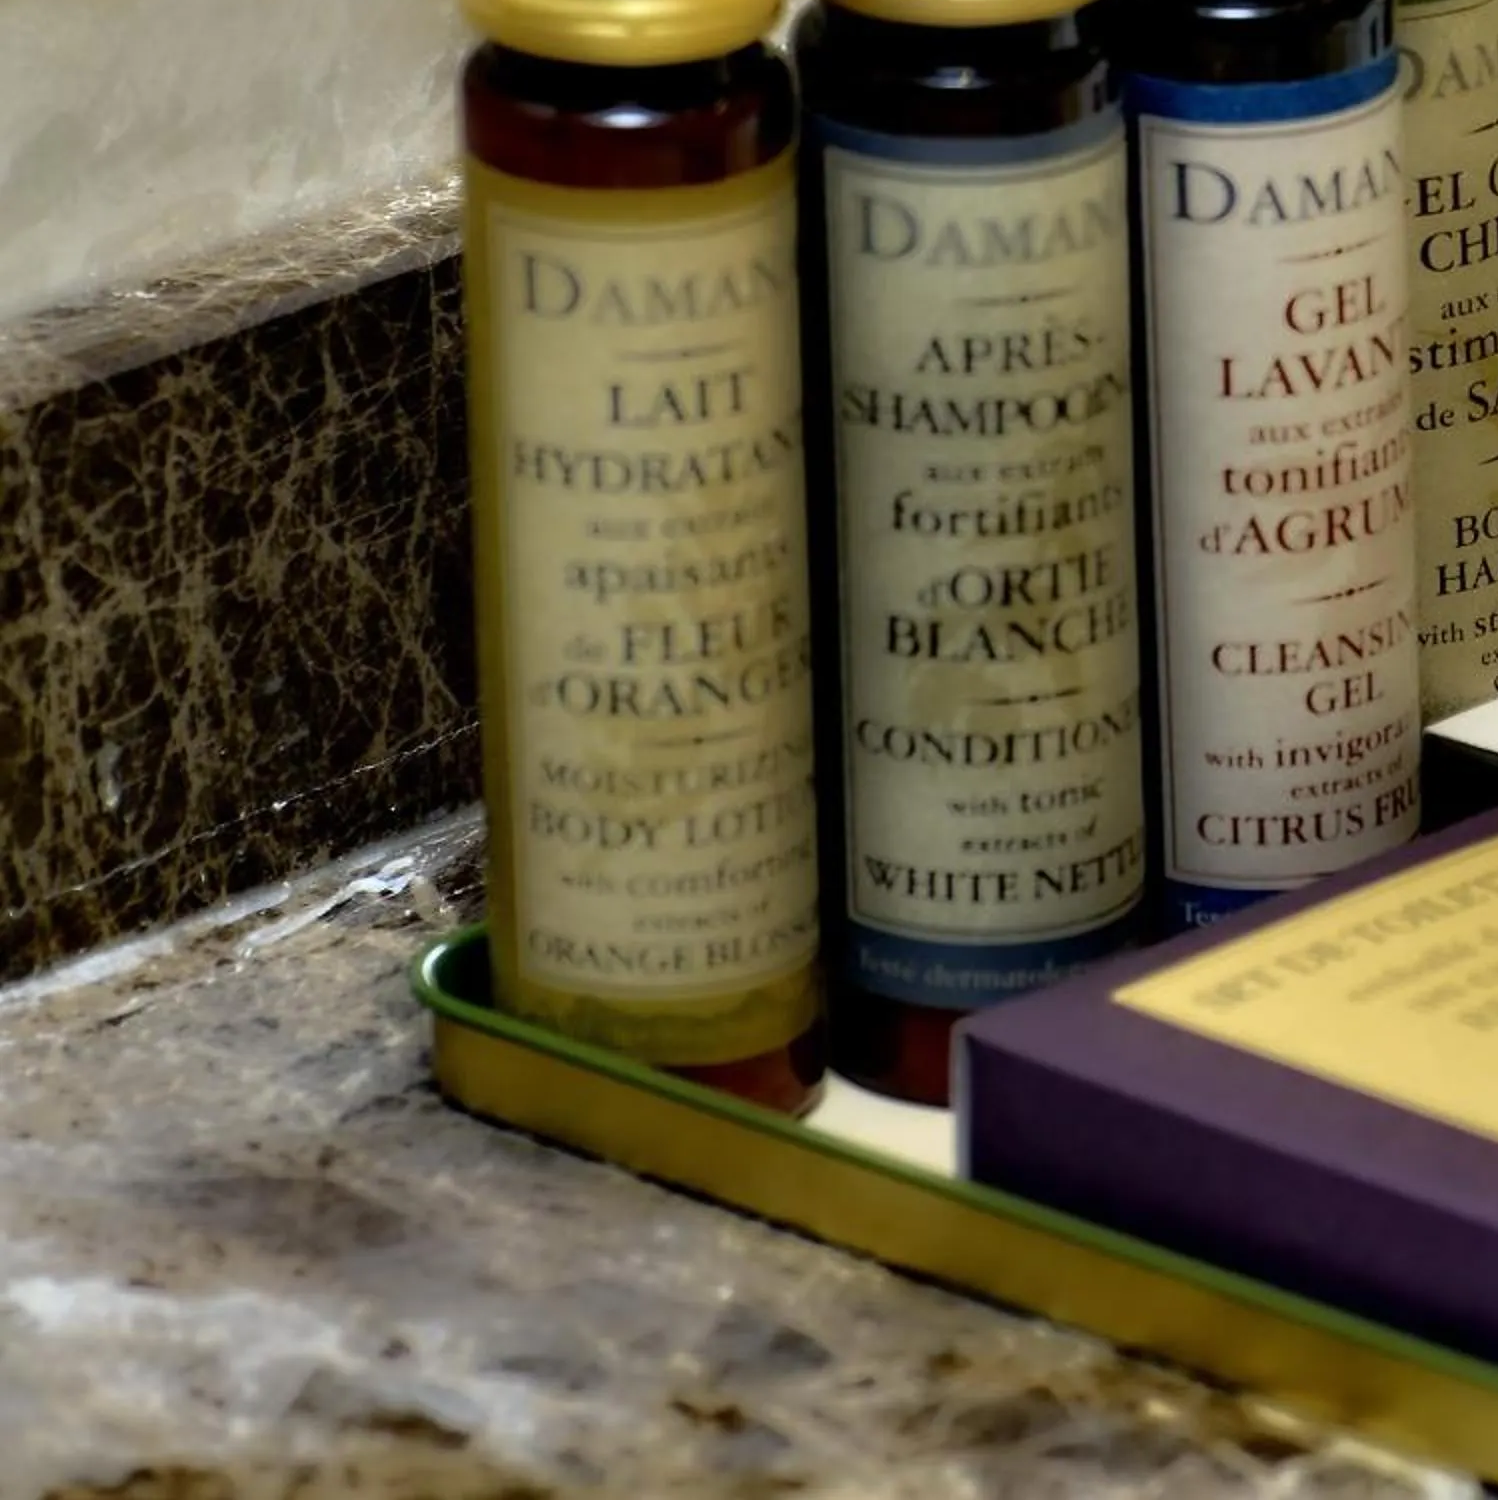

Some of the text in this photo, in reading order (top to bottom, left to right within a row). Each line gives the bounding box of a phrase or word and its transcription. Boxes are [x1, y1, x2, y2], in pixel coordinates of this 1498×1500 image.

[1415, 172, 1476, 218] EL
[1285, 276, 1386, 335] GEL
[1441, 294, 1488, 321] aux
[608, 366, 755, 427] LAIT
[1416, 403, 1455, 431] de
[1307, 671, 1385, 717] GEL
[1204, 746, 1264, 770] with
[1291, 771, 1382, 800] extracts
[529, 801, 661, 849] BODY
[1197, 806, 1364, 847] CITRUS
[865, 855, 1020, 903] WHITE
